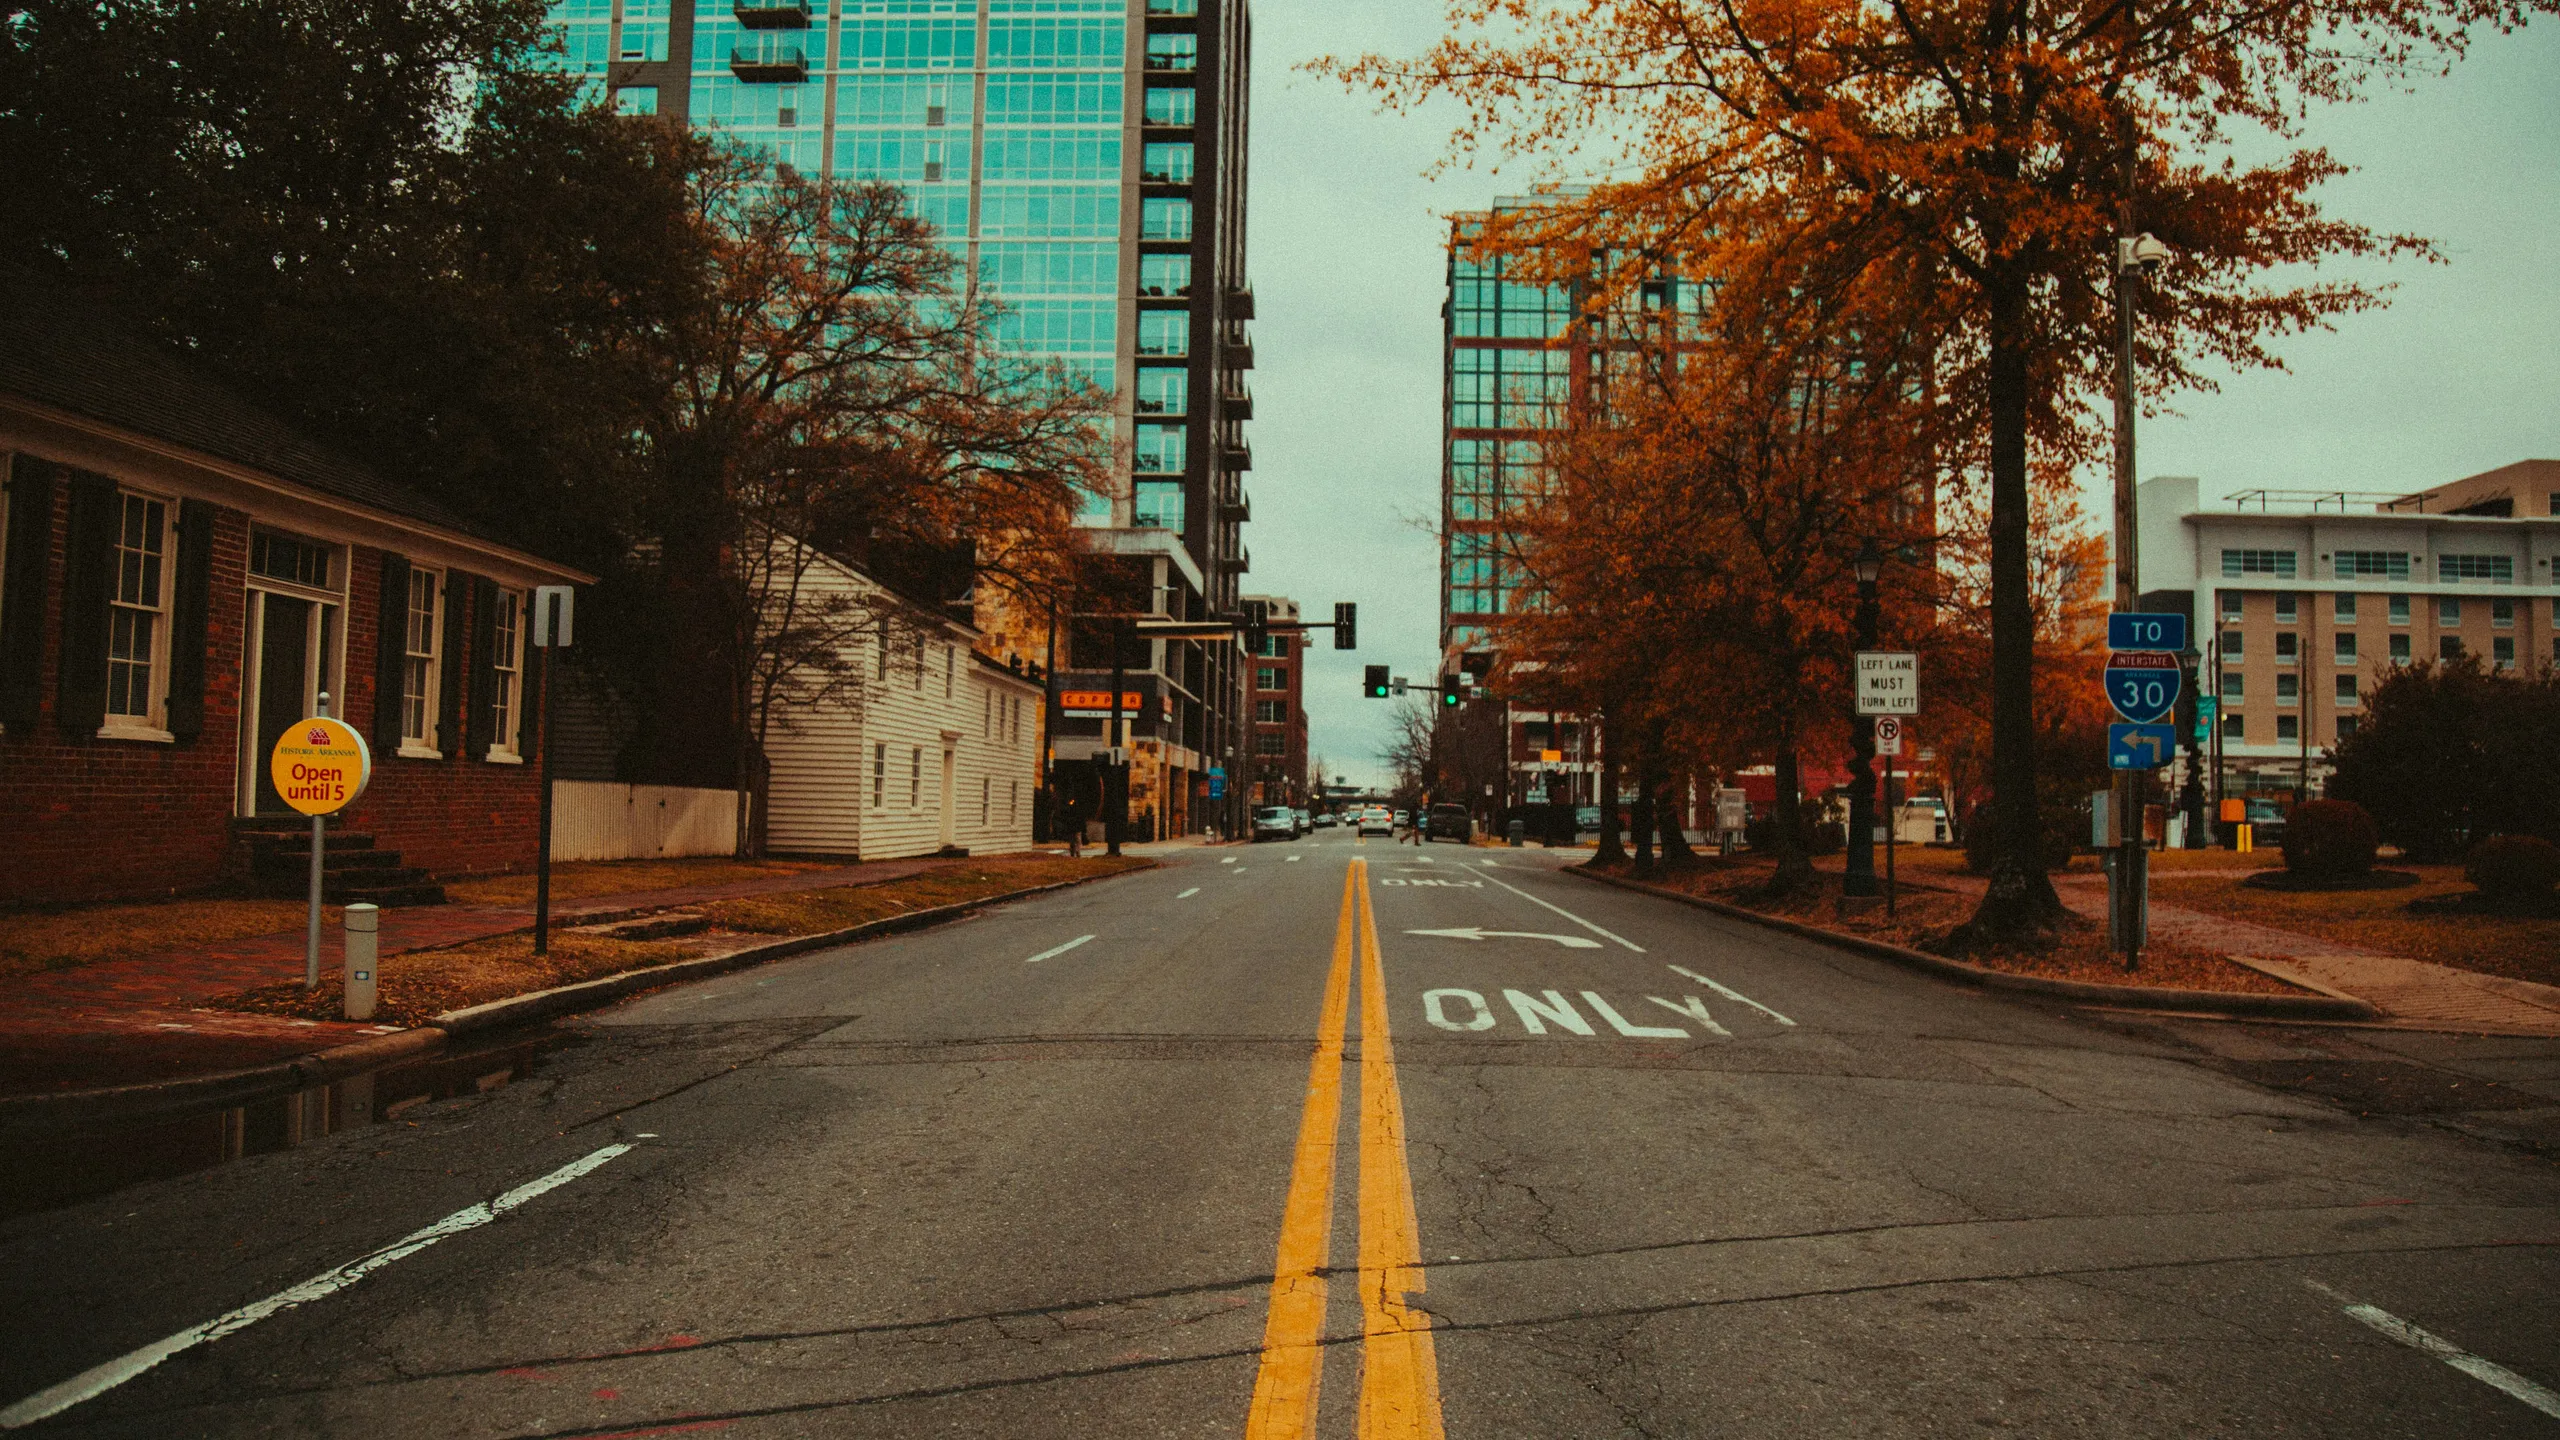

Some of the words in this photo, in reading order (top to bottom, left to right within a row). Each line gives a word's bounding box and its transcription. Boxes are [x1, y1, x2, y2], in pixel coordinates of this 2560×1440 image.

[2131, 622, 2162, 642] TO
[1861, 660, 1883, 670] LEFT
[1889, 660, 1913, 670] LANE
[2117, 656, 2168, 666] INTERSTATE
[1871, 677, 1904, 690] MUST
[1066, 695, 1137, 705] COPPR
[2122, 681, 2164, 708] 30
[1861, 697, 1886, 707] TURN
[1892, 697, 1915, 708] LEFT
[319, 748, 356, 756] ARKANSAS
[292, 763, 342, 785] Open
[288, 783, 330, 800] until
[334, 785, 344, 801] 5
[1382, 879, 1484, 888] ONLY
[1422, 988, 1733, 1037] ONLY
